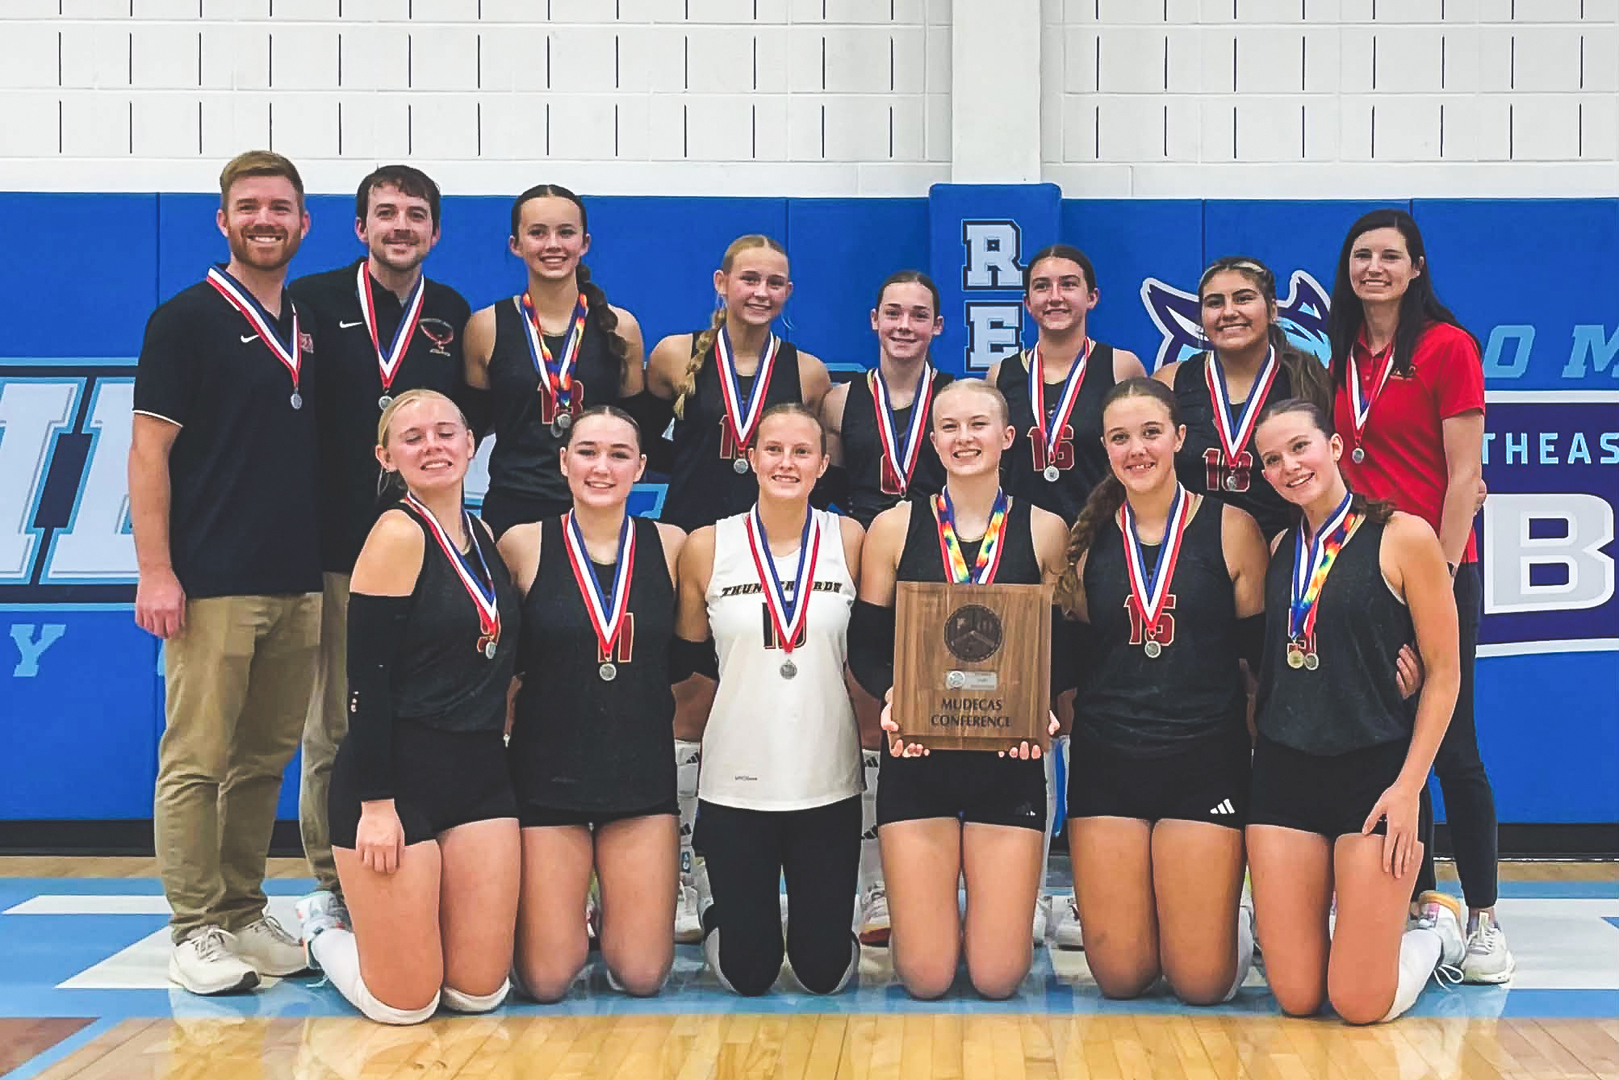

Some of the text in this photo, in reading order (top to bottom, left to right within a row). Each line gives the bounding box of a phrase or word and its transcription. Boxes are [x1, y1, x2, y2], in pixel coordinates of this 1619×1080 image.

[1026, 424, 1075, 472] 16
[1202, 448, 1253, 492] 18
[720, 580, 842, 597] THUNRRDS
[1123, 594, 1177, 647] 15
[942, 698, 1003, 711] MUDECAS
[931, 714, 1011, 728] CONFERENCE
